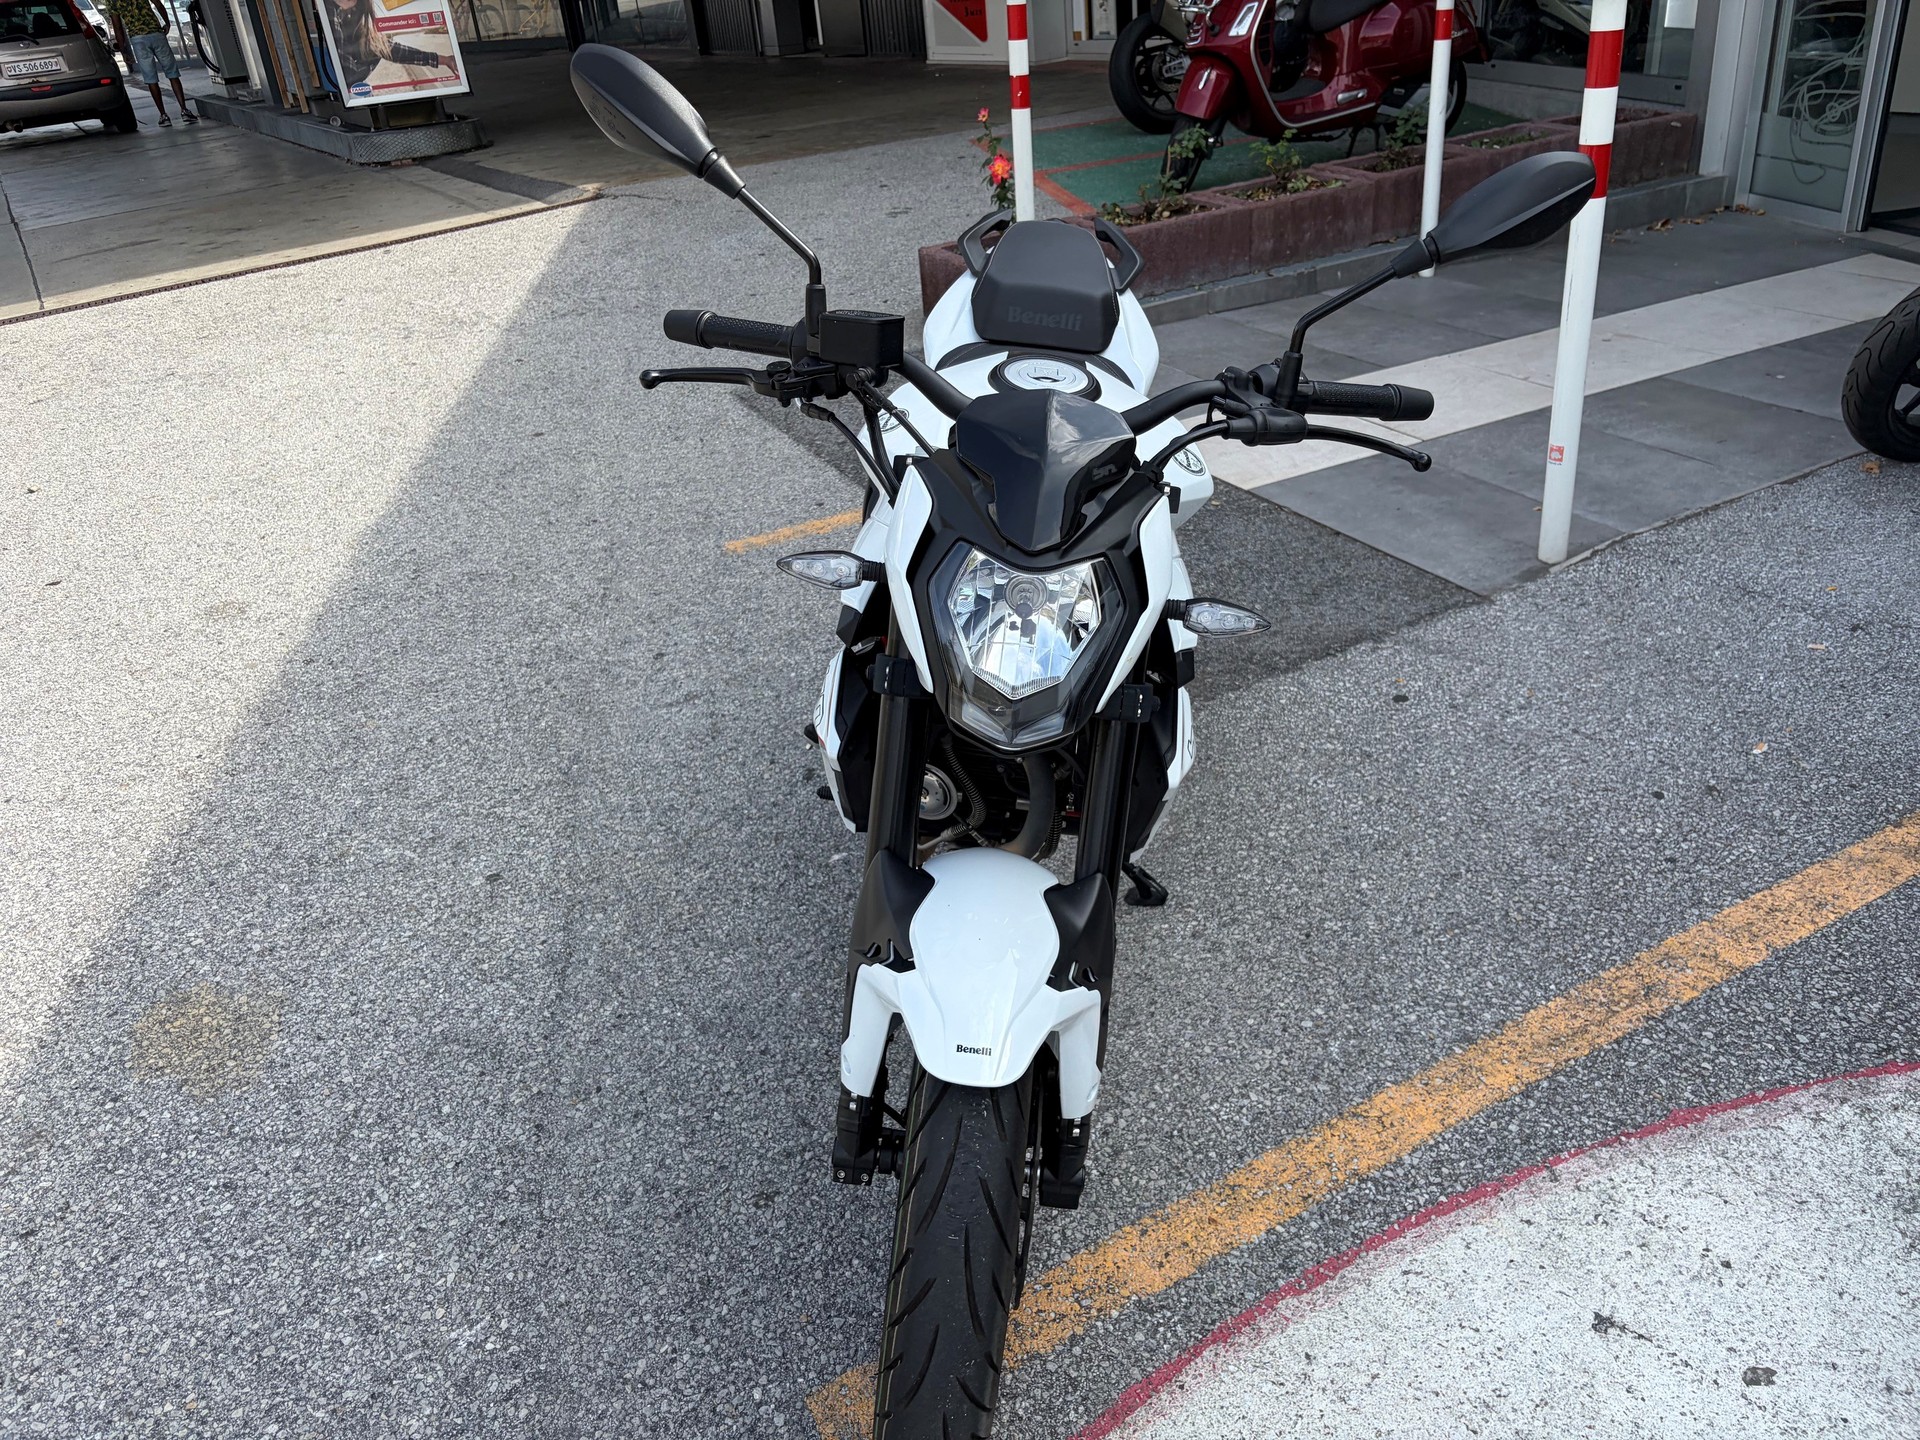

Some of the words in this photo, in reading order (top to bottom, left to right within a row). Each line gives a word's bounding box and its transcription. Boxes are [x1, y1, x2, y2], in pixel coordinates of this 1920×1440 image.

[378, 19, 408, 28] Commander
[1008, 306, 1082, 331] Benelli
[956, 1044, 992, 1056] Benelli
